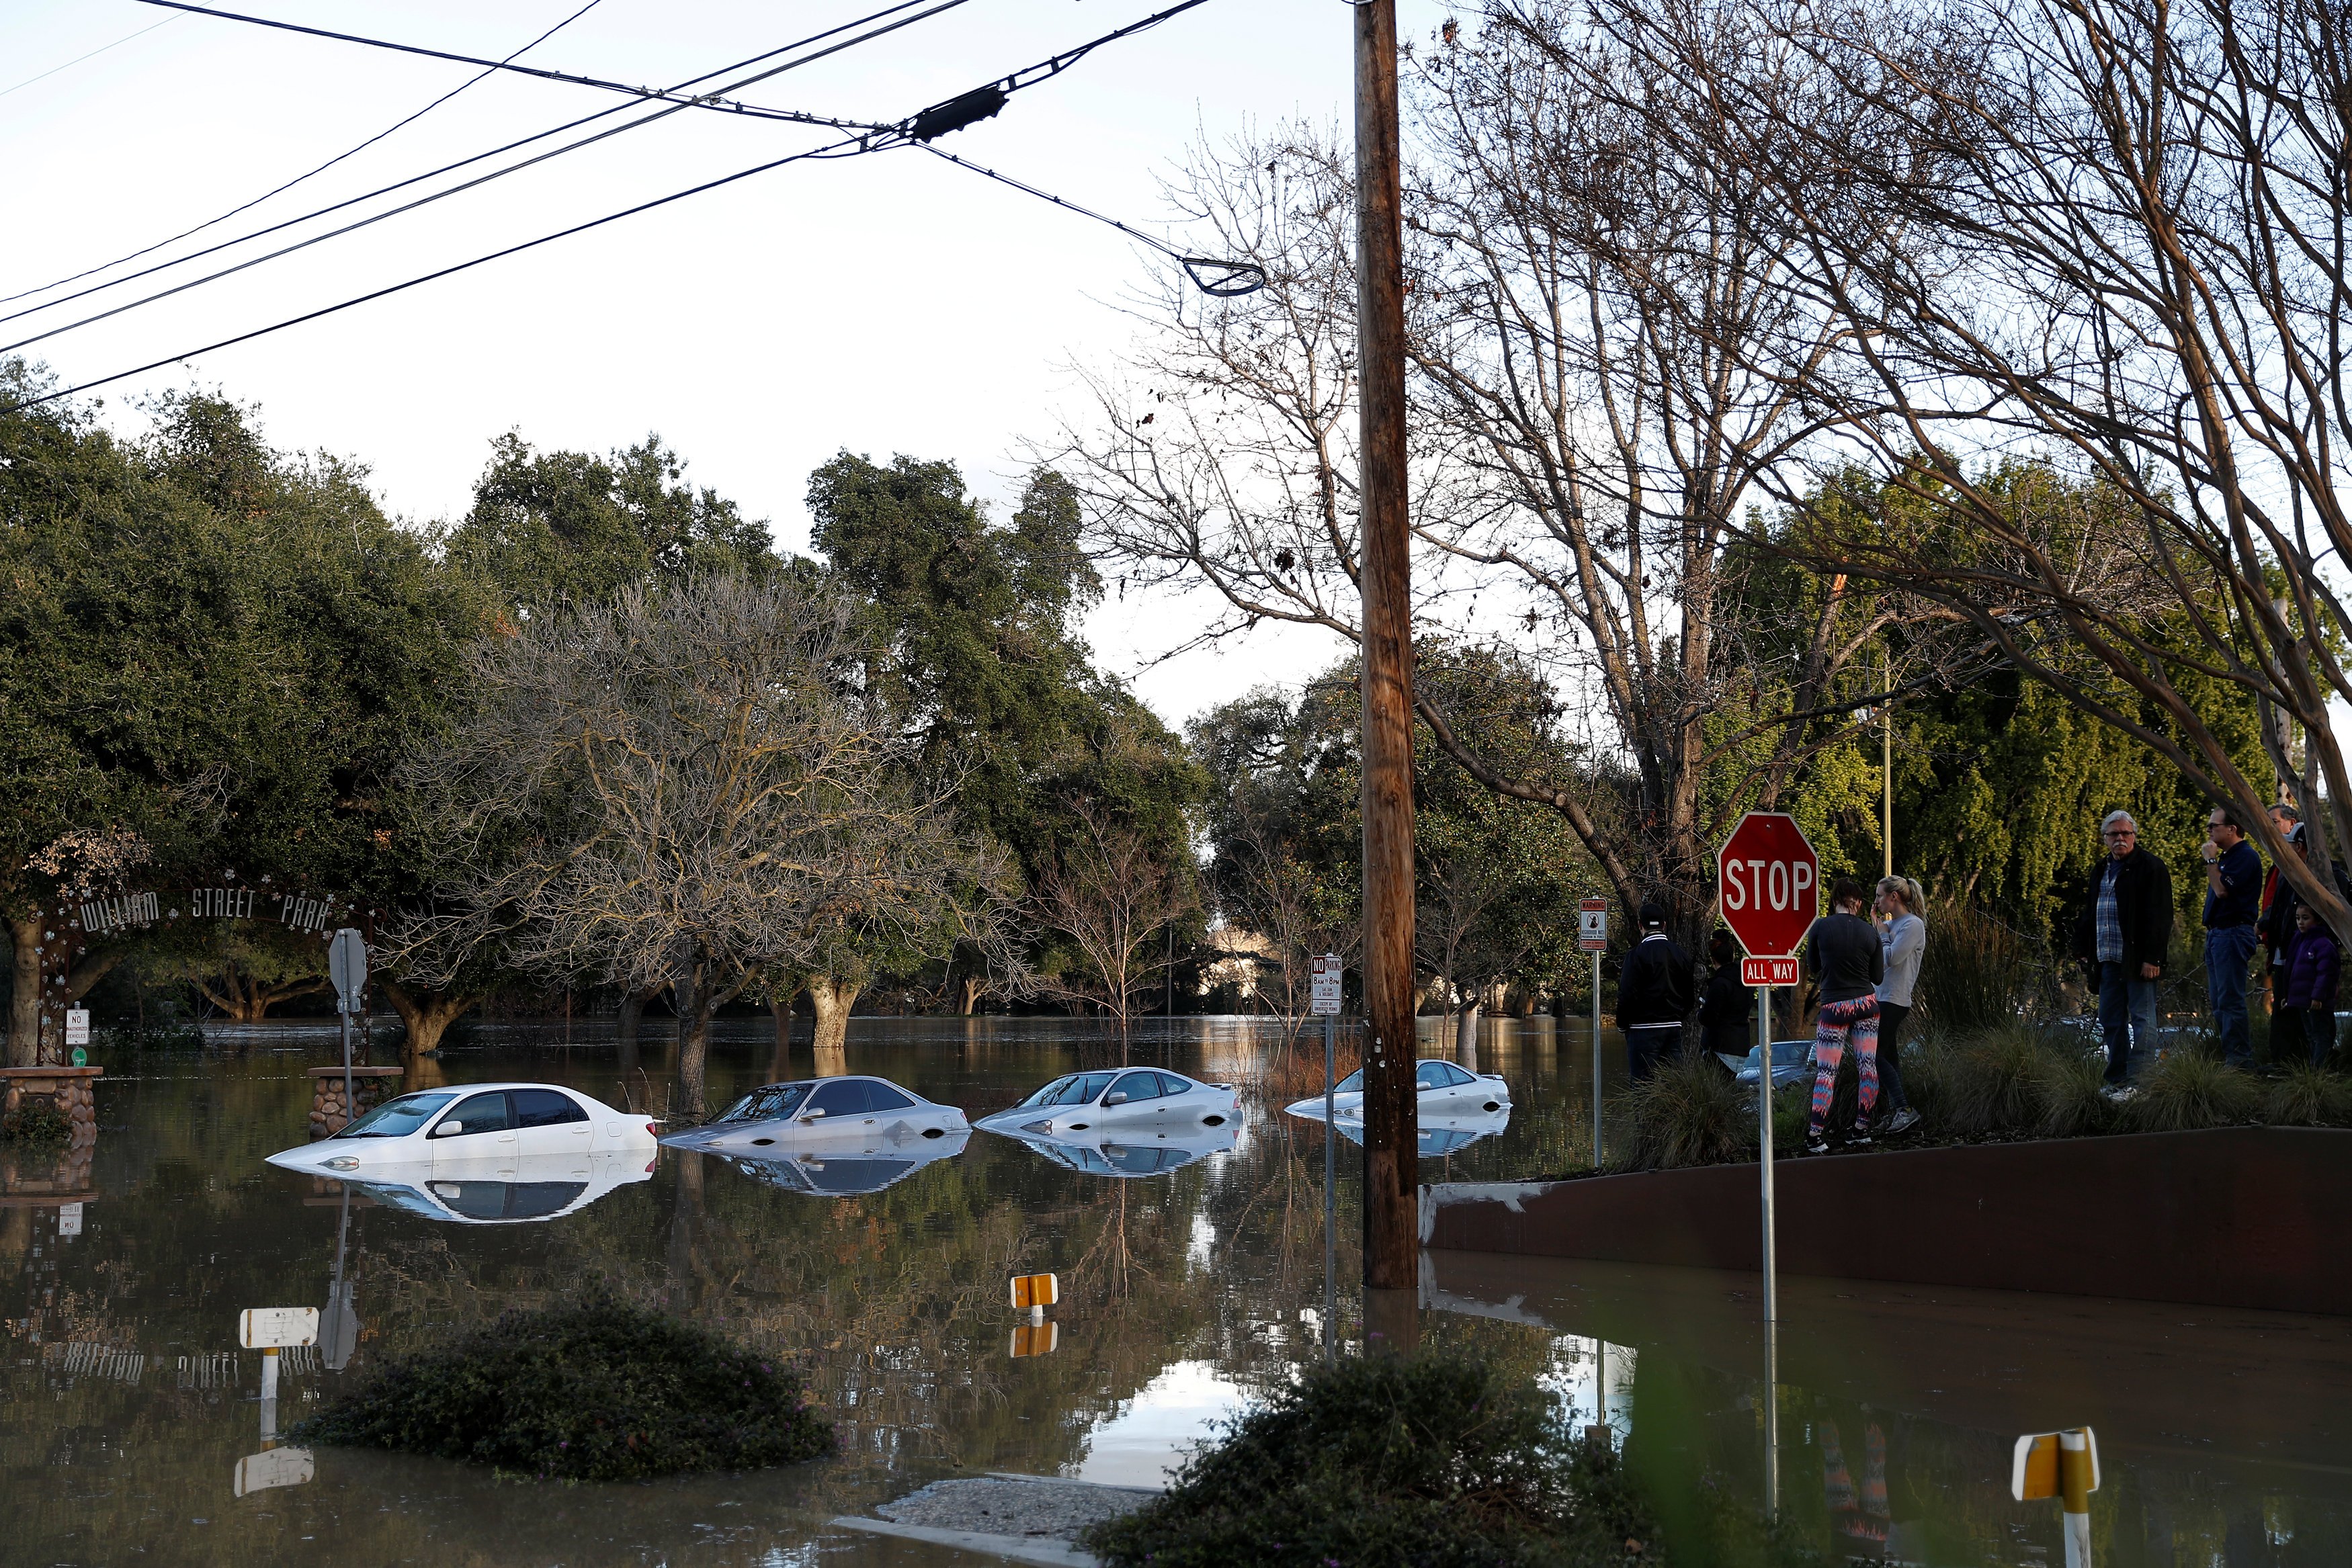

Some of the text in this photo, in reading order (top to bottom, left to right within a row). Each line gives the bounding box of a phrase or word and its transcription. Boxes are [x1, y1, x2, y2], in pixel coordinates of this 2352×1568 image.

[1726, 859, 1812, 911] STOP
[80, 888, 330, 932] WILLIAM STREET PARK
[1314, 959, 1340, 971] NO PARKING
[1747, 963, 1794, 979] ALL WAY
